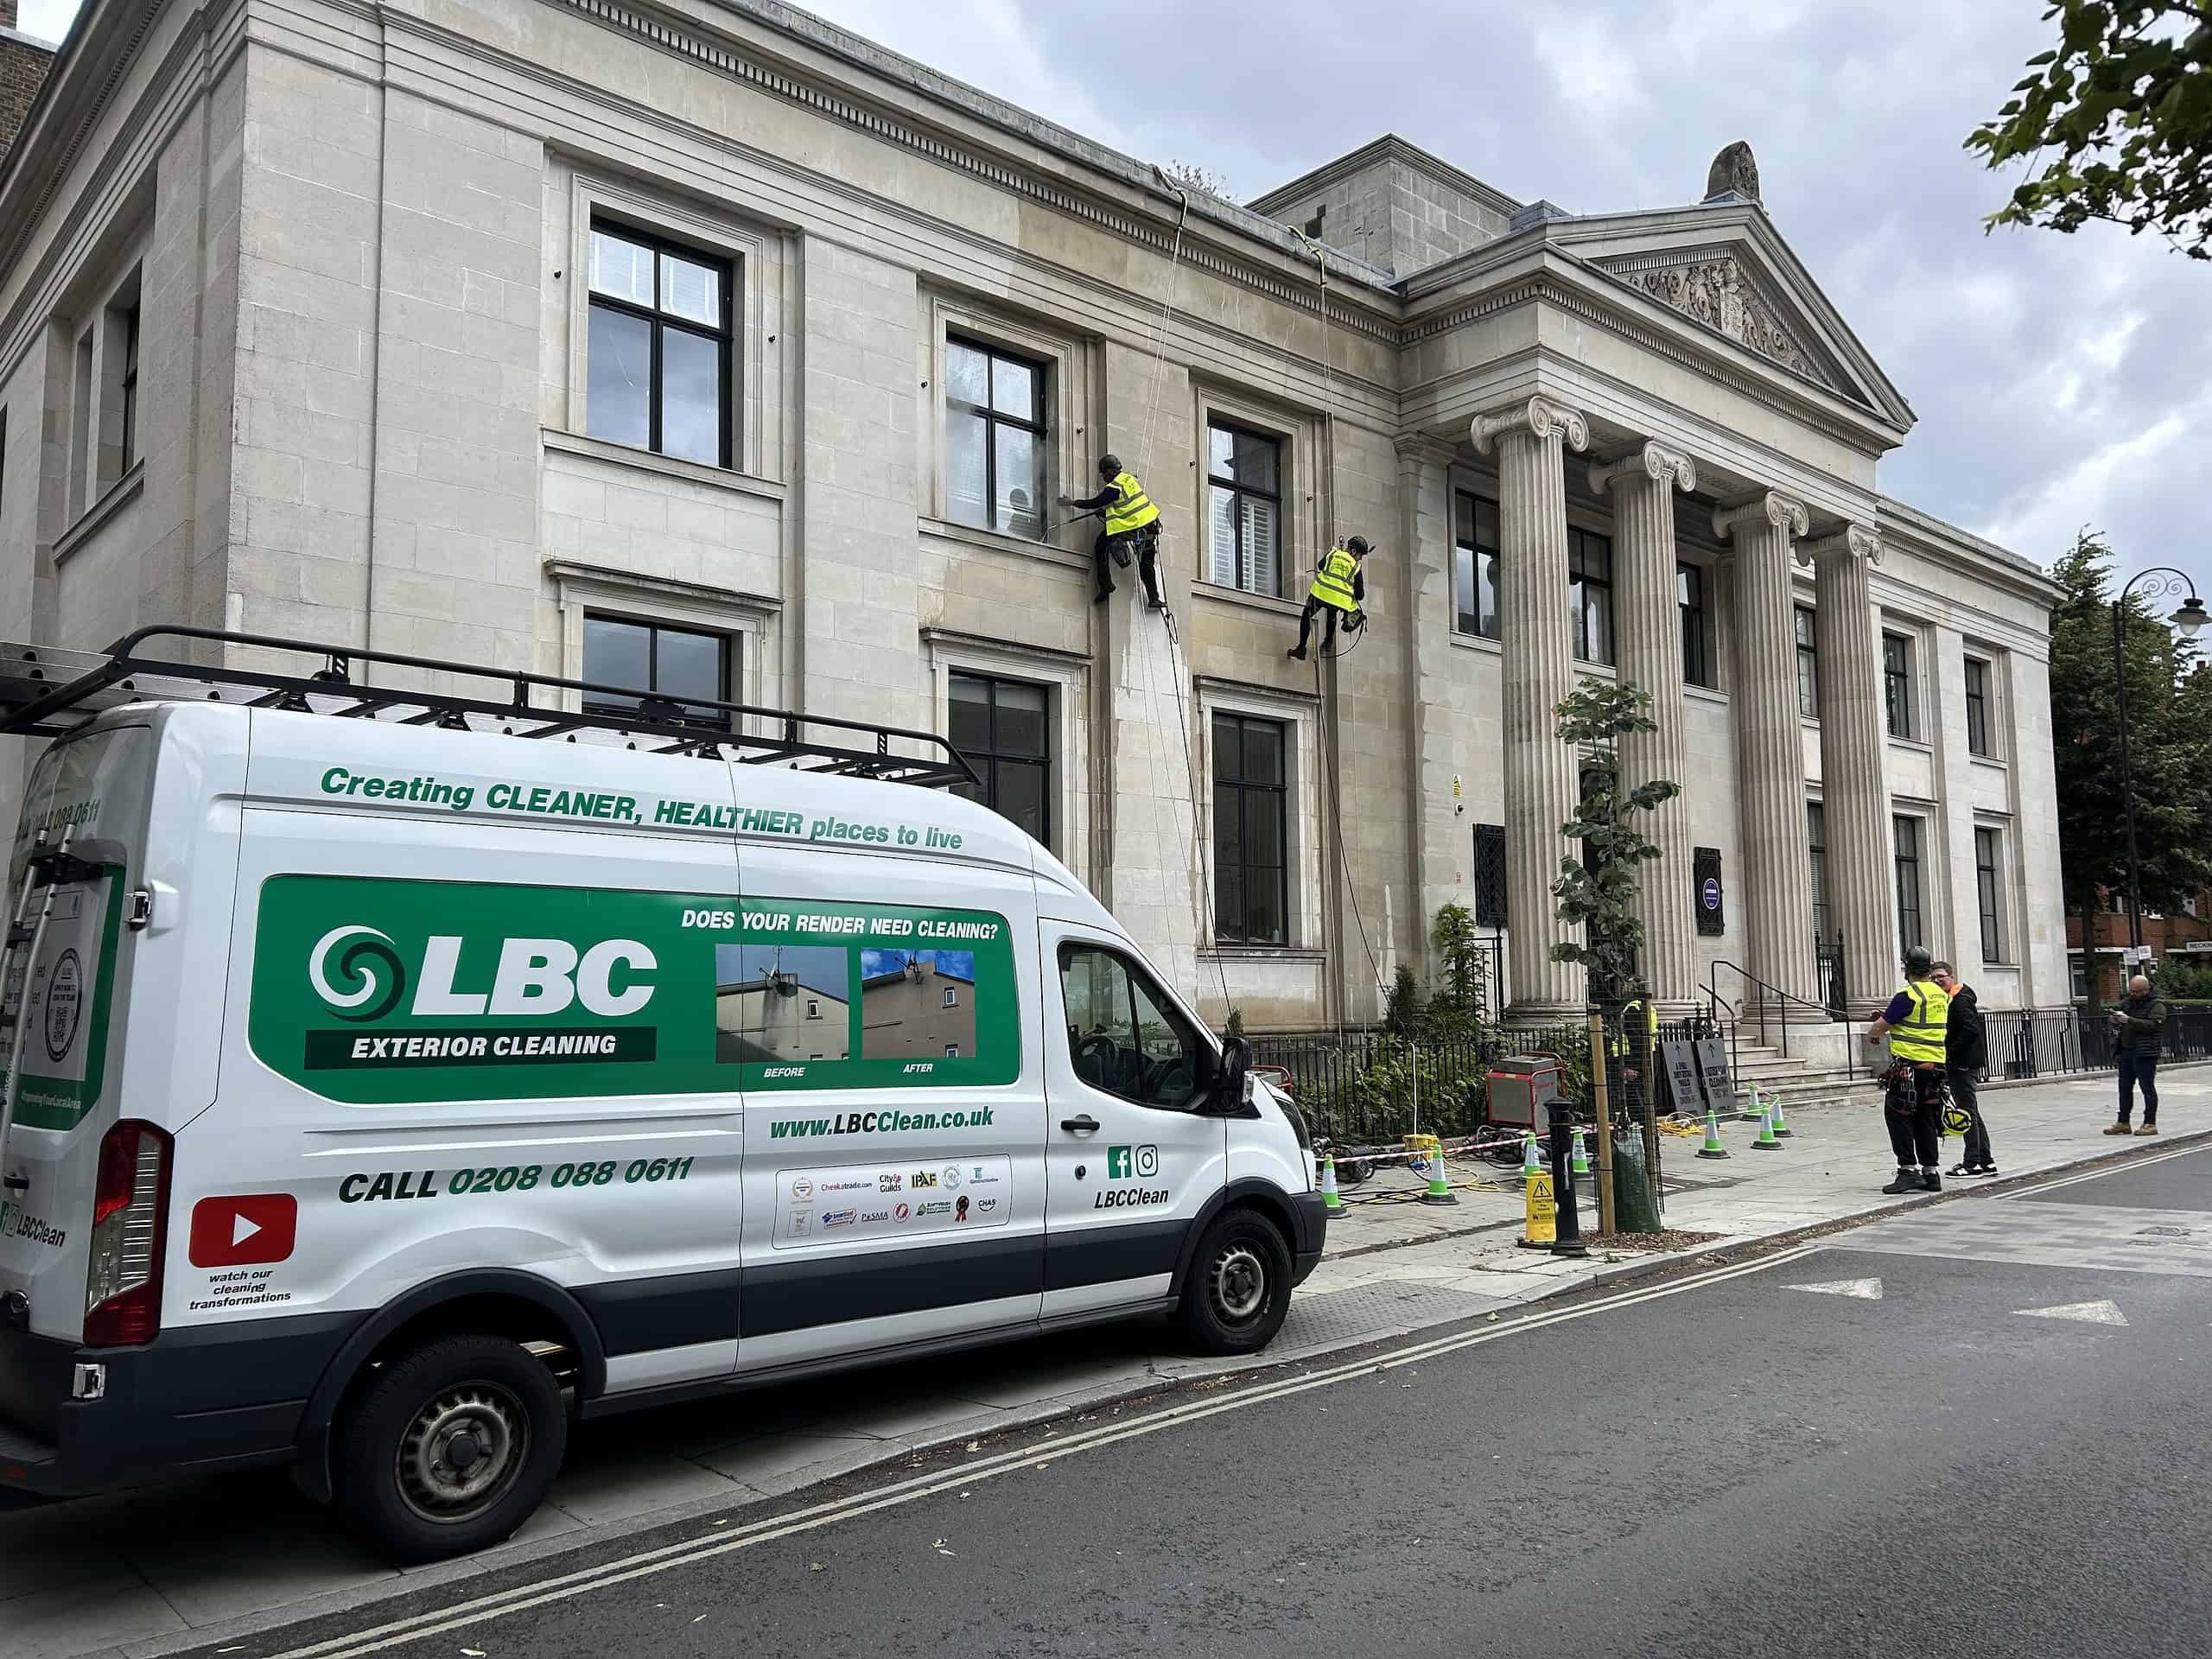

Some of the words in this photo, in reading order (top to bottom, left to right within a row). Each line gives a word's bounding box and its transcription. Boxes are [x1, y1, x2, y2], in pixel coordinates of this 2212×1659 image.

[321, 767, 474, 810] Creating
[486, 784, 642, 824] CLEANER,
[654, 800, 803, 834] HEALTHIER
[810, 815, 888, 842] places
[897, 825, 918, 845] to
[925, 825, 963, 849] live
[681, 909, 735, 930] DOES
[741, 912, 791, 931] YOUR
[795, 914, 866, 934] RENDER
[869, 918, 913, 936] NEED
[917, 920, 999, 940] CLEANING?
[410, 934, 658, 1017] LBC
[351, 1036, 487, 1058] EXTERIOR
[493, 1034, 617, 1056] CLEANING
[763, 1067, 805, 1078] BEFORE
[902, 1062, 934, 1073] AFTER
[770, 1105, 995, 1139] www.LBCClean.co.uk
[338, 1170, 439, 1204] CALL
[448, 1165, 540, 1195] 0208
[550, 1160, 616, 1189] 088
[624, 1156, 695, 1185] 0611
[912, 1171, 937, 1188] IPAF
[978, 1198, 996, 1208] CHAS
[1094, 1187, 1169, 1209] LBCClean
[16, 1214, 66, 1248] LBCClean
[209, 1271, 247, 1284] watch
[251, 1269, 273, 1281] our
[213, 1281, 266, 1297] cleaning
[189, 1294, 291, 1311] transformations
